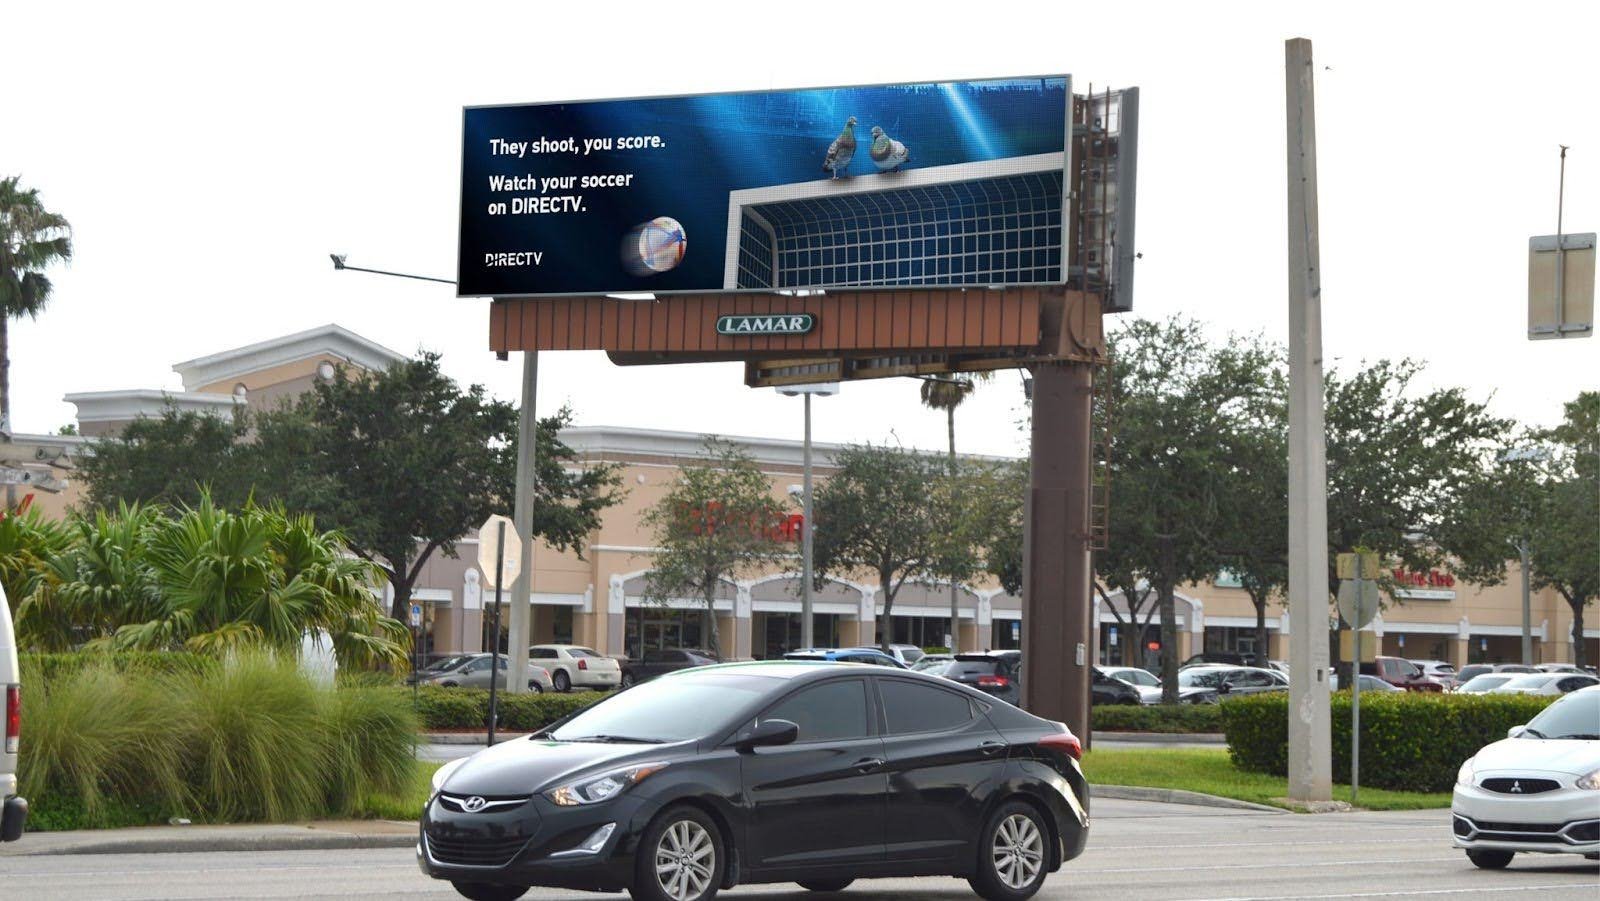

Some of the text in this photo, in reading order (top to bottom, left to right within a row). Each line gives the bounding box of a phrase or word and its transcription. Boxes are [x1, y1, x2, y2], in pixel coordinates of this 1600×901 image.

[489, 135, 666, 159] They shoot, you score.
[488, 174, 634, 194] Watch your soccer
[487, 196, 587, 216] on DIRECTV.
[485, 251, 543, 267] DIRECTV
[725, 317, 804, 331] LAMAR
